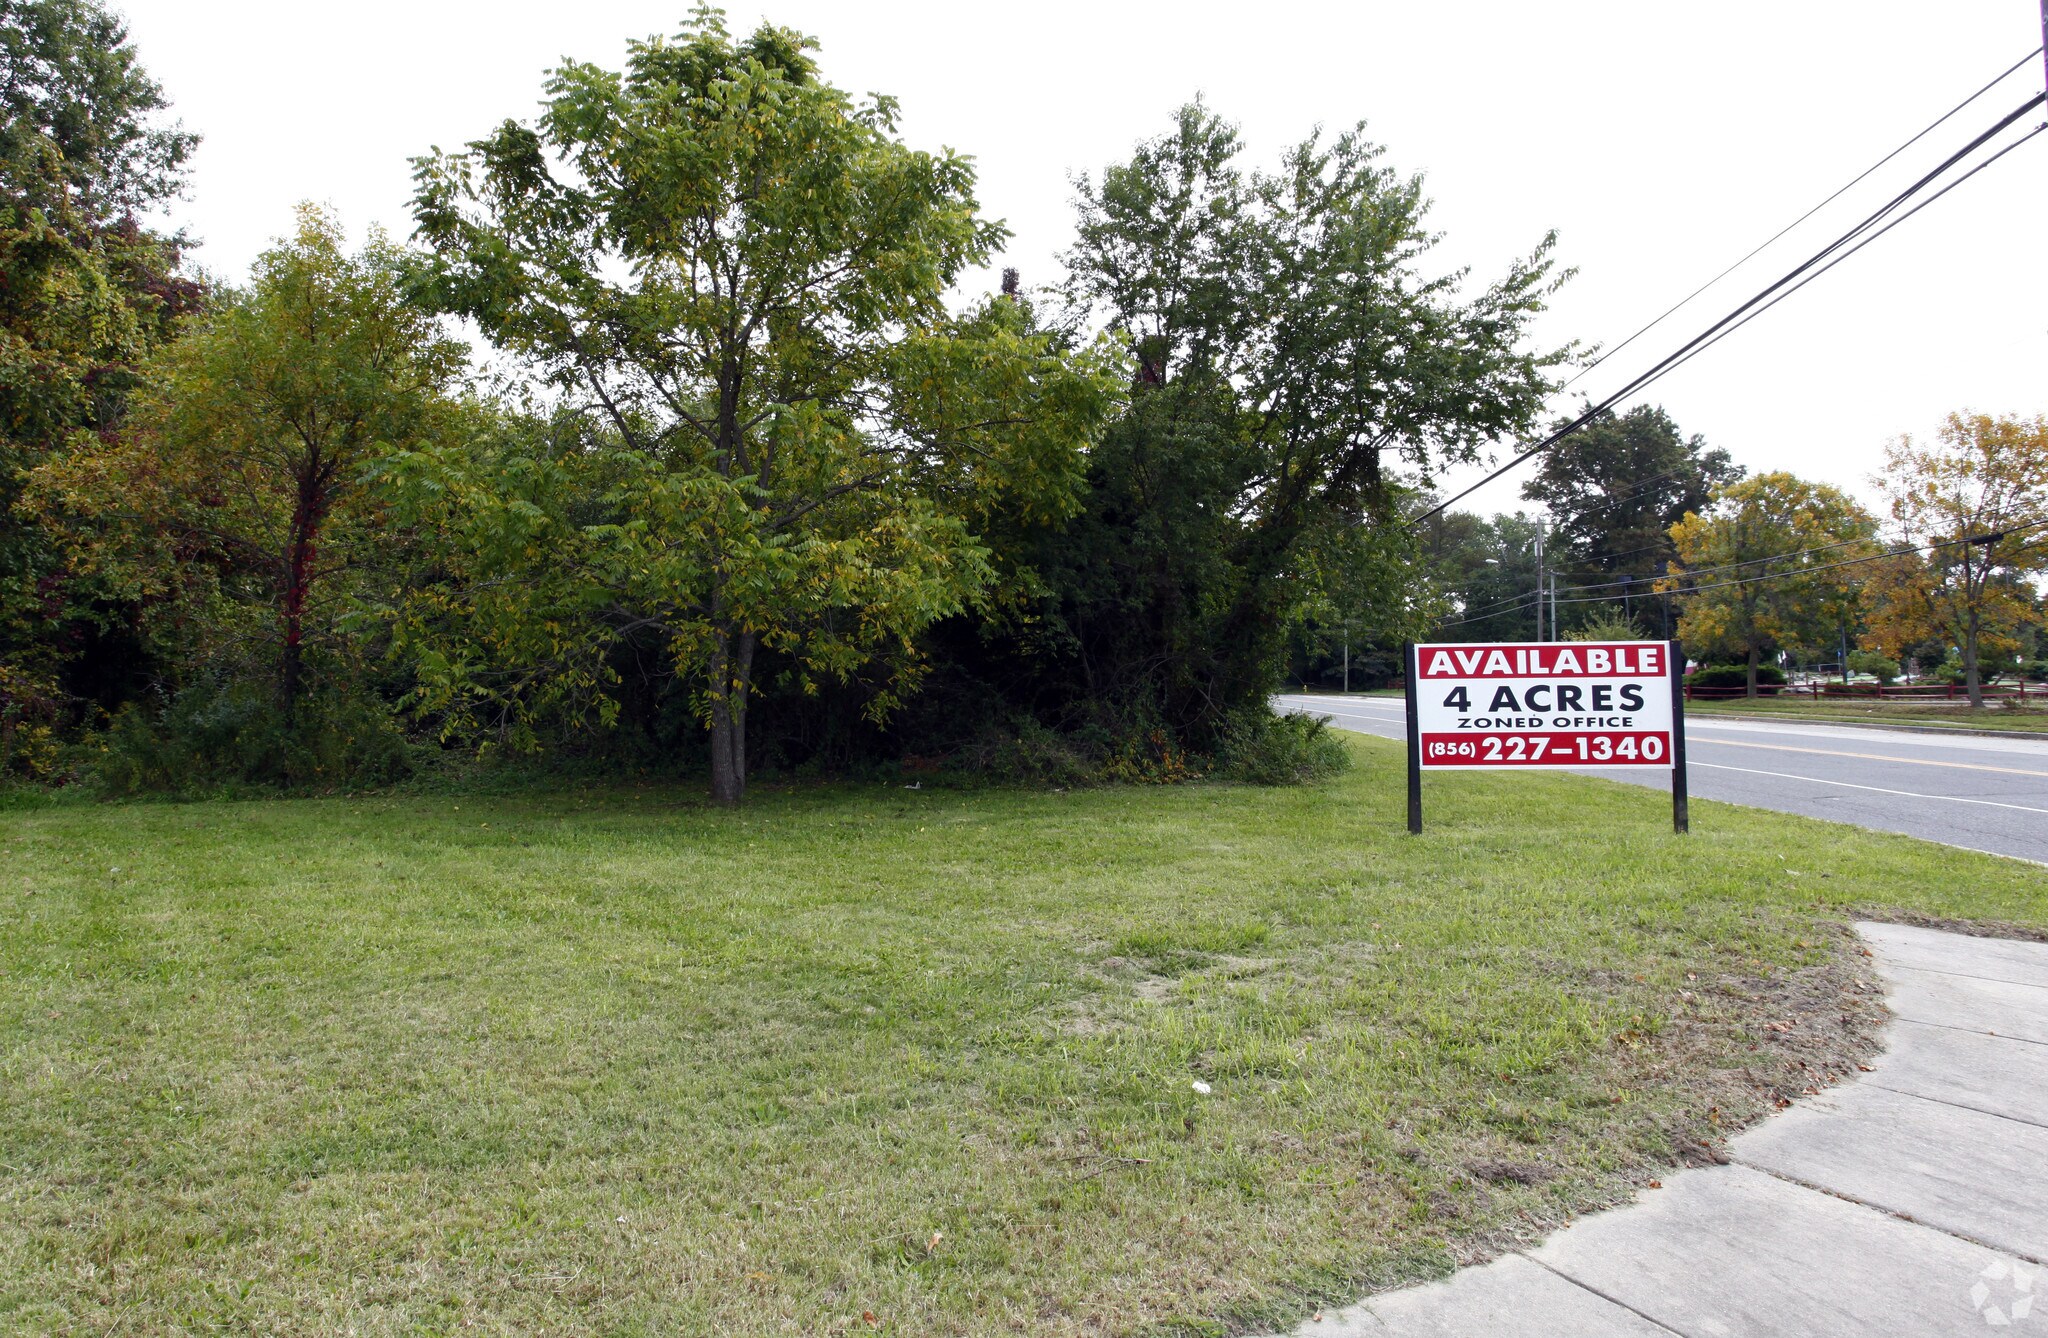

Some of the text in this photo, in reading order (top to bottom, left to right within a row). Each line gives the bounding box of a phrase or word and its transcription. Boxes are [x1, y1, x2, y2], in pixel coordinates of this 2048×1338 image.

[1427, 648, 1658, 675] AVAILABLE
[1443, 684, 1644, 713] 4 ACRES
[1457, 716, 1633, 729] ZONED OFFICE
[1428, 736, 1663, 761] (856) 227-1340
